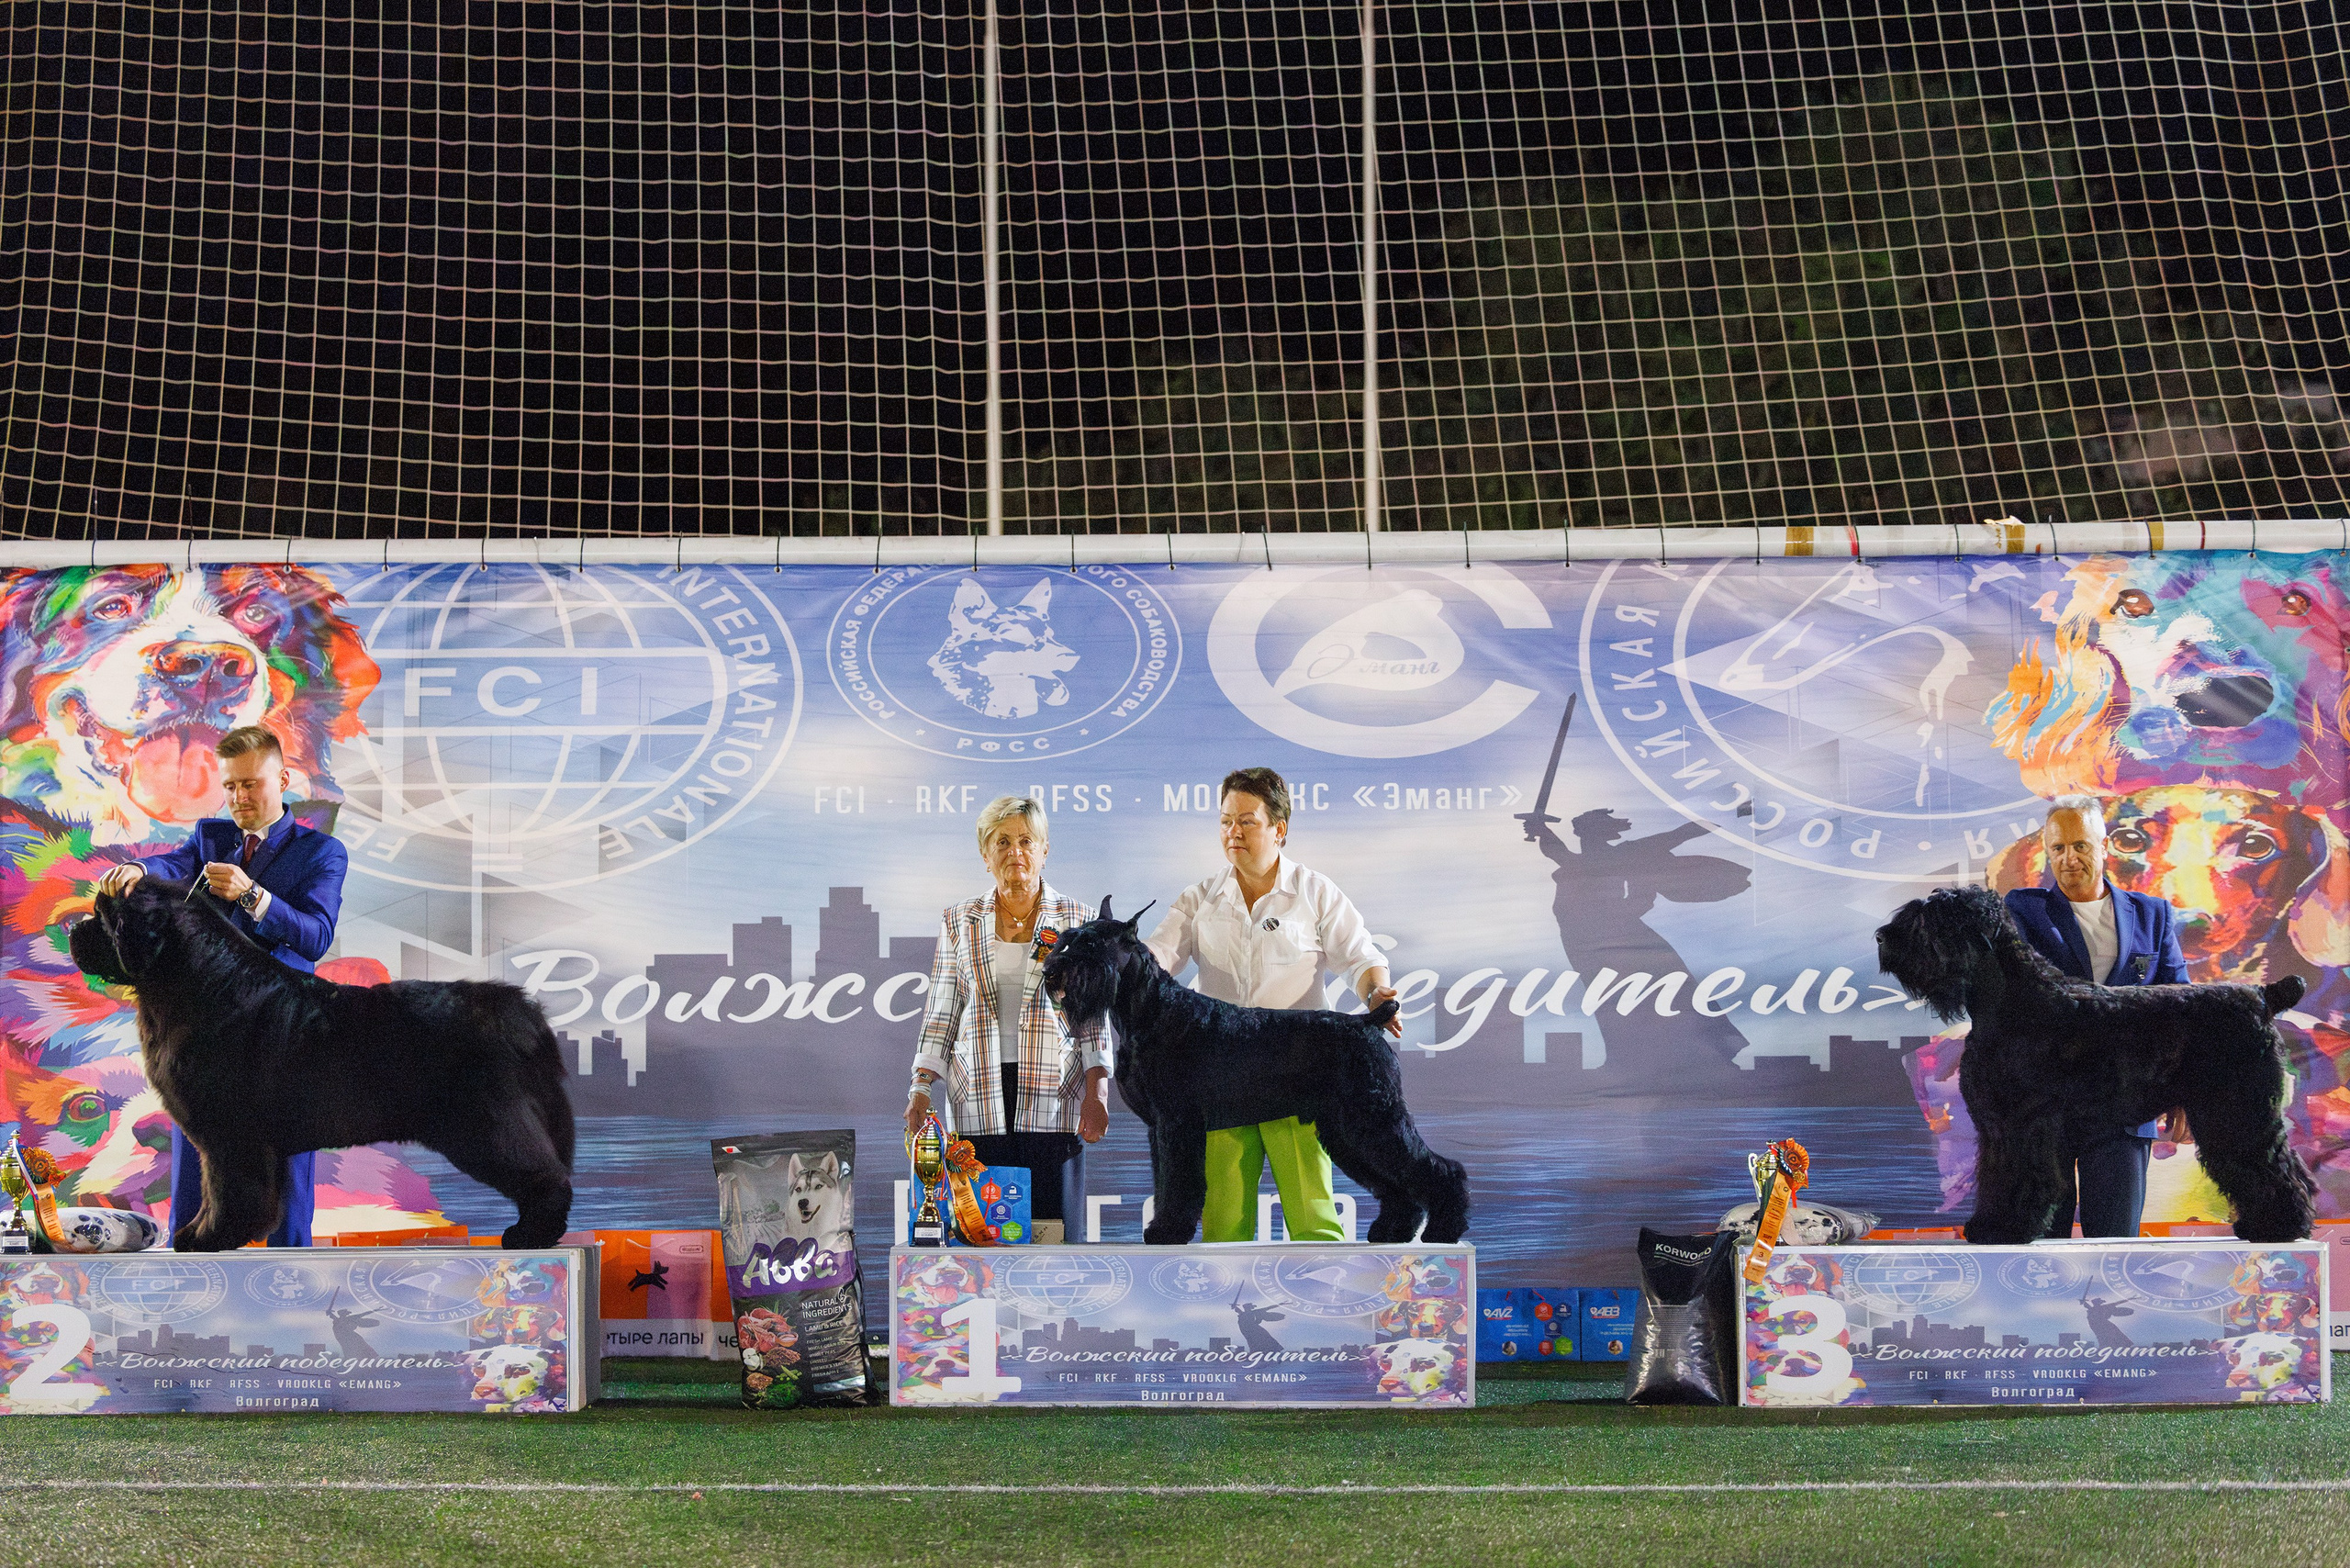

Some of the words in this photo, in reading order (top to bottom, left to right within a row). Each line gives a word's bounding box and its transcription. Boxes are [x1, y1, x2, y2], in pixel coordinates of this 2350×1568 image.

[839, 620, 897, 720] РОССИЙСКАЯ
[1111, 589, 1168, 718] СОБАКОВОДСТВА
[404, 666, 599, 718] FCI
[591, 565, 781, 860] INTERNATIONALE
[1608, 603, 1883, 860] РОССИЙСКАЯ
[957, 736, 1051, 753] РФСС
[814, 785, 865, 814] FCI
[916, 784, 979, 813] RKF
[1029, 784, 1113, 813] RFSS
[1352, 781, 1524, 811] «Эманг»
[510, 948, 931, 1027] Волжс
[801, 1297, 839, 1309] NATURAL
[802, 1303, 853, 1319] INGREDIENTS
[607, 1332, 653, 1345] тыре
[657, 1332, 704, 1345] лапы
[804, 1324, 823, 1332] LAMB
[9, 1303, 96, 1400] 2
[941, 1298, 1022, 1393] 1
[1000, 1345, 1176, 1363] «Волжский
[1184, 1344, 1371, 1367] победитель»
[1765, 1294, 1853, 1394] 3
[1850, 1339, 2025, 1361] «Волжский
[2034, 1340, 2221, 1364] победитель»
[95, 1351, 272, 1372] «Волжский
[281, 1350, 464, 1375] победитель»
[1908, 1371, 1929, 1381] FCI
[1944, 1370, 1967, 1380] RKF
[1985, 1369, 2016, 1380] RFSS
[2093, 1367, 2158, 1379] «EMANG»
[153, 1378, 174, 1390] FCI
[189, 1378, 212, 1389] RKF
[229, 1377, 261, 1389] RFSS
[339, 1378, 402, 1390] «EMANG»
[1058, 1372, 1079, 1383] FCI
[1094, 1372, 1119, 1383] RKF
[1135, 1372, 1166, 1383] RFSS
[1244, 1372, 1308, 1383] «EMANG»
[236, 1395, 319, 1408] Волгоград
[1140, 1390, 1225, 1403] Волгоград
[1991, 1386, 2076, 1398] Волгоград
